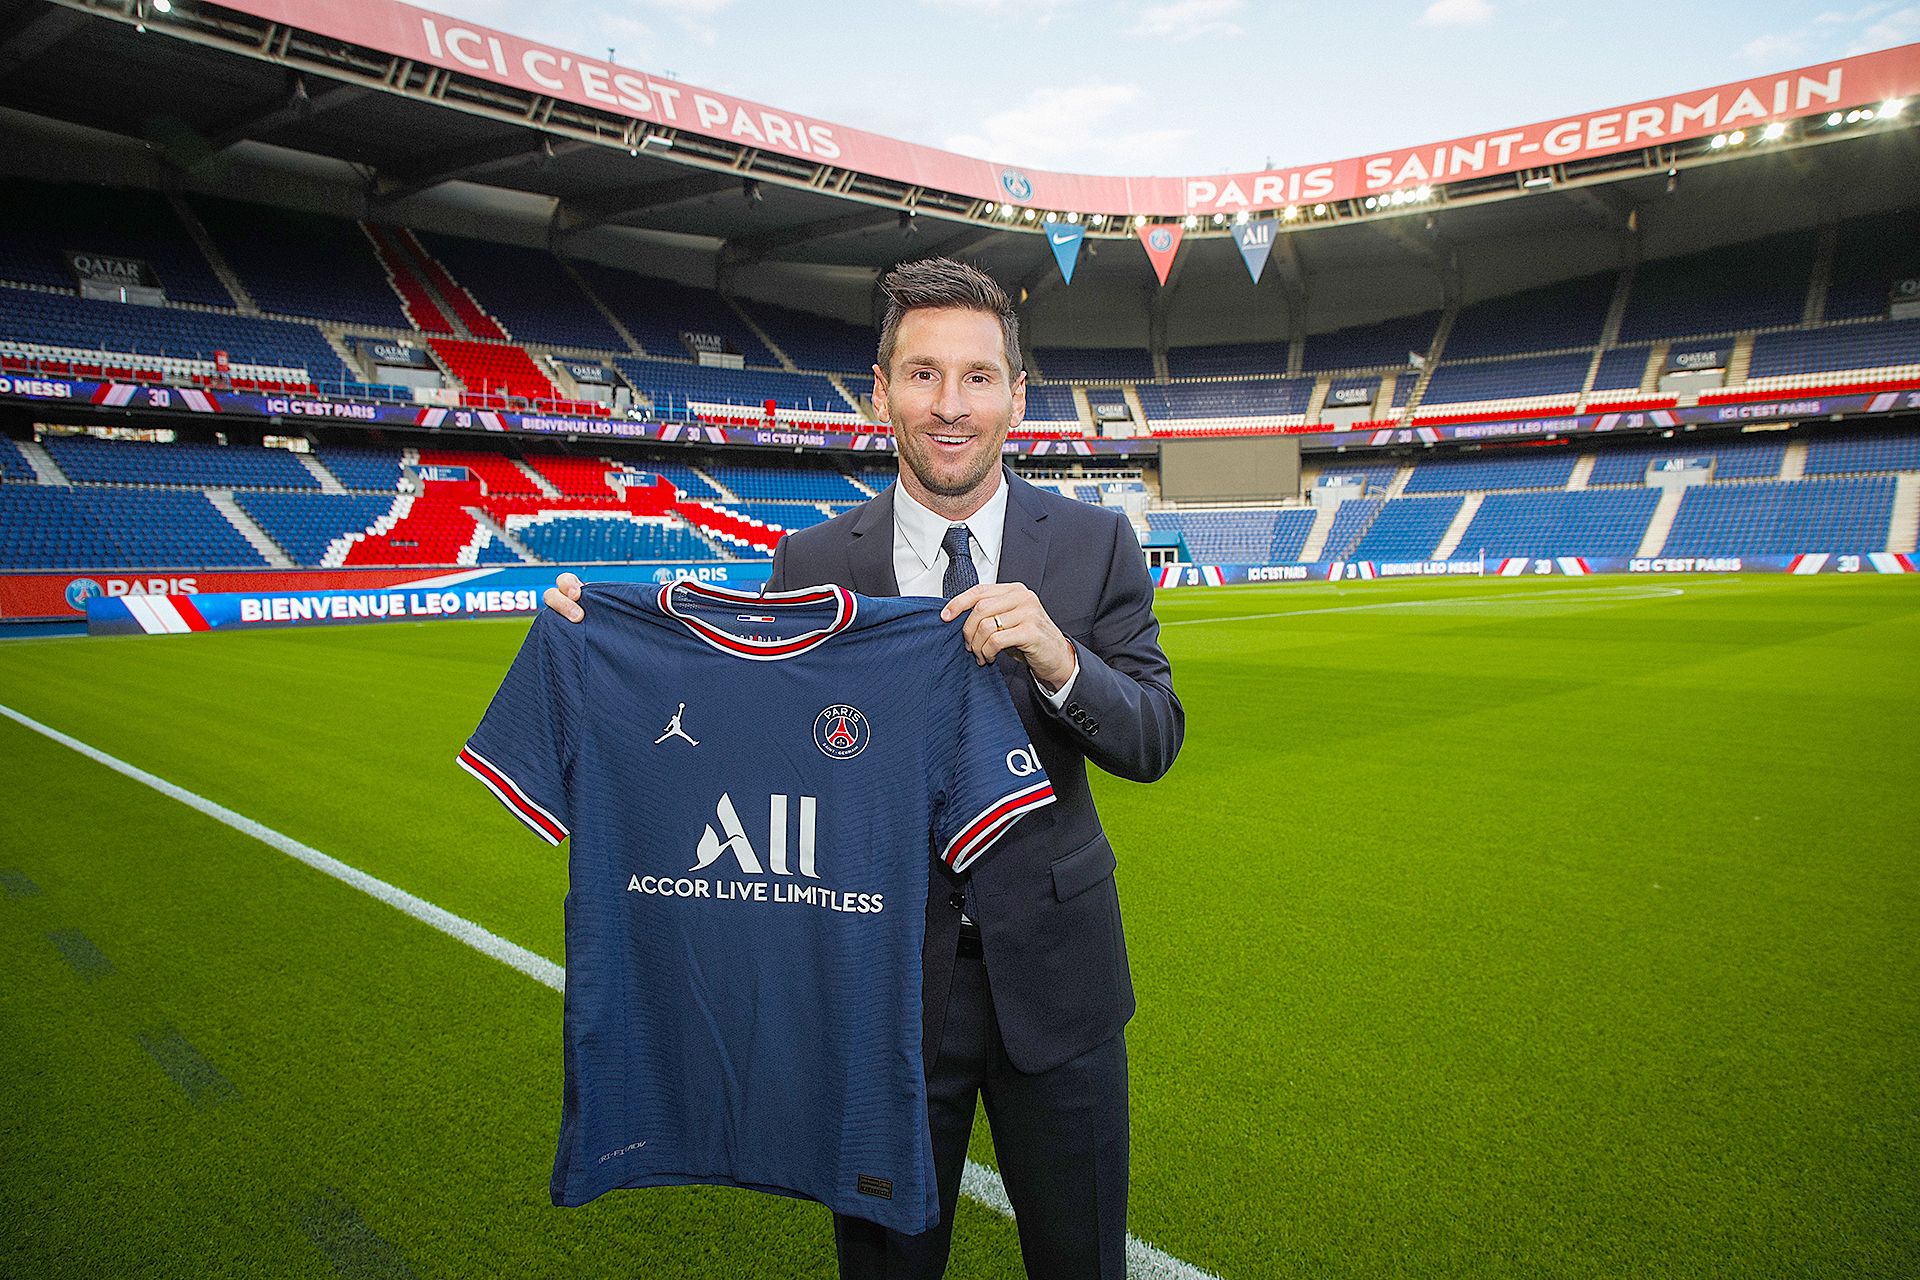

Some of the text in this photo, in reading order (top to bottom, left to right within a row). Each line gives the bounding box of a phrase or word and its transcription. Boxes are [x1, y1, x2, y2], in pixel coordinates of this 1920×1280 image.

[421, 18, 842, 160] ICI C'EST PARIS
[1187, 67, 1844, 208] PARIS SAINT-GERMAIN
[73, 256, 140, 279] QATAR
[13, 378, 73, 399] MESSI
[147, 388, 171, 407] 30
[266, 398, 289, 414] ICI
[334, 403, 376, 420] PARIS
[1718, 406, 1739, 420] ICI
[1778, 400, 1822, 416] PARIS
[455, 412, 472, 428] 30
[521, 417, 646, 437] BIENVENUE LEO MESSI
[1454, 419, 1579, 438] BIENVENUE LEO MESSI
[1626, 413, 1644, 428] 30
[687, 427, 701, 441] 30
[757, 431, 771, 444] ICI
[799, 434, 826, 446] PARIS
[1397, 429, 1413, 443] 30
[874, 437, 888, 450] 30
[1055, 442, 1068, 454] 30
[1423, 562, 1447, 574] LEO
[1629, 559, 1651, 572] ICI
[1695, 557, 1742, 572] PARIS
[1837, 554, 1860, 572] 30
[675, 567, 728, 581] PARIS
[1186, 568, 1199, 586] 30
[107, 578, 199, 596] PARIS
[240, 590, 537, 622] BIENVENUE LEO MESSI
[824, 707, 861, 722] PARIS
[626, 873, 884, 914] ACCOR LIVE LIMITLESS
